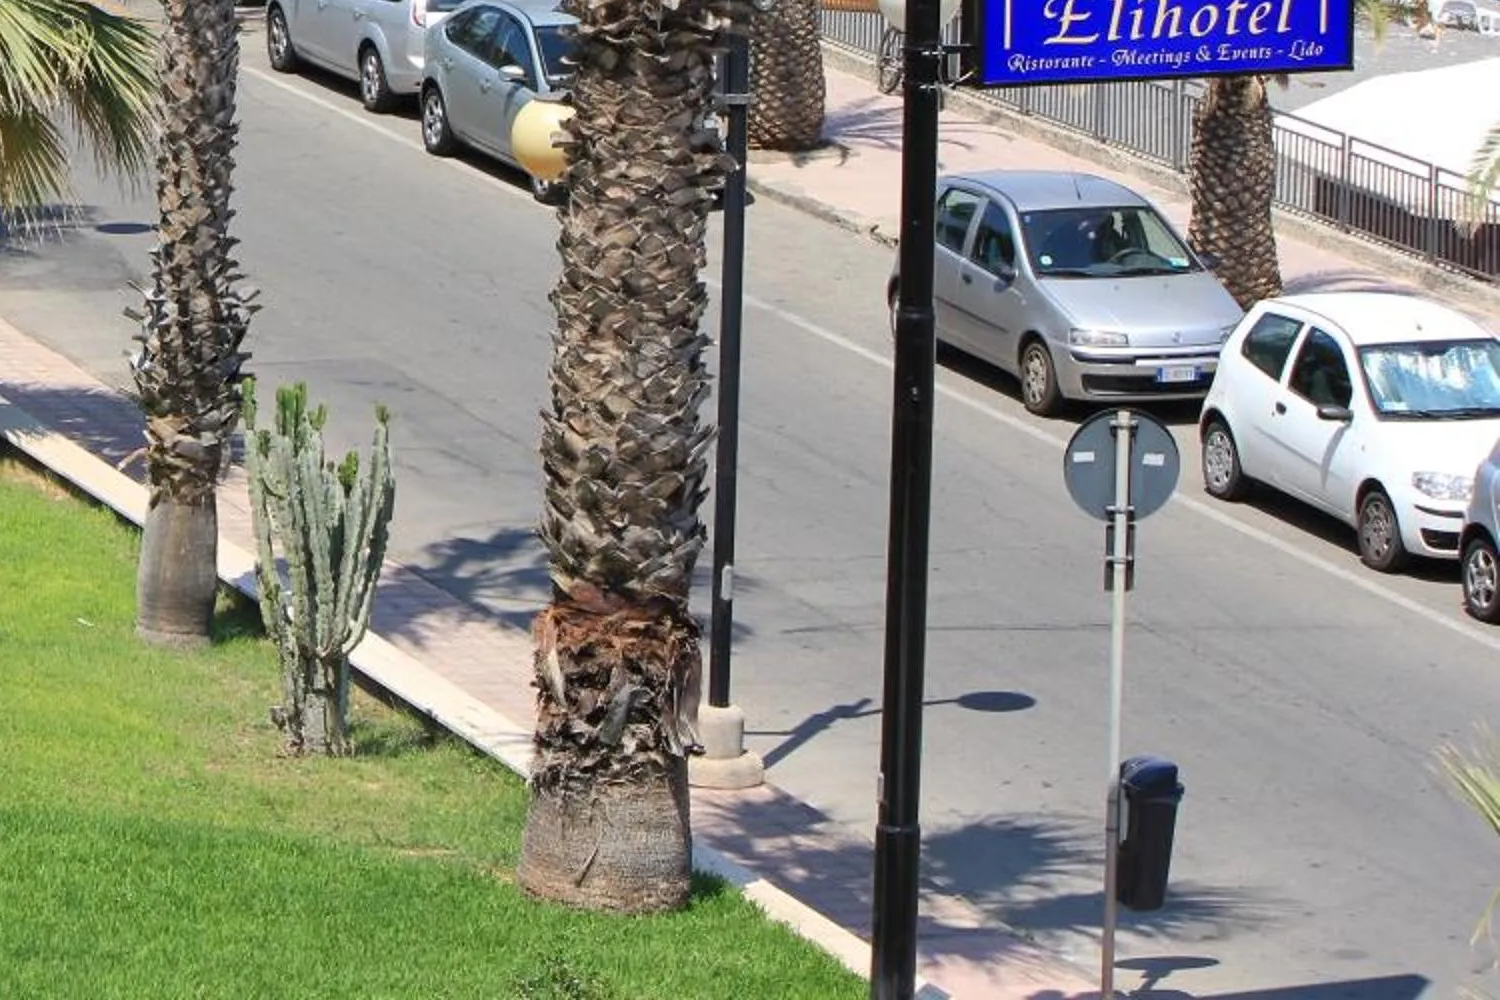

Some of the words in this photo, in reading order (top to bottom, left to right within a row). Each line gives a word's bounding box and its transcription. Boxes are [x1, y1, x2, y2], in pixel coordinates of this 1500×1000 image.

[1007, 53, 1095, 72] Ristorante
[1111, 48, 1191, 69] Meetings
[1195, 46, 1212, 62] &
[1217, 43, 1272, 61] Events
[1287, 40, 1324, 60] Lido
